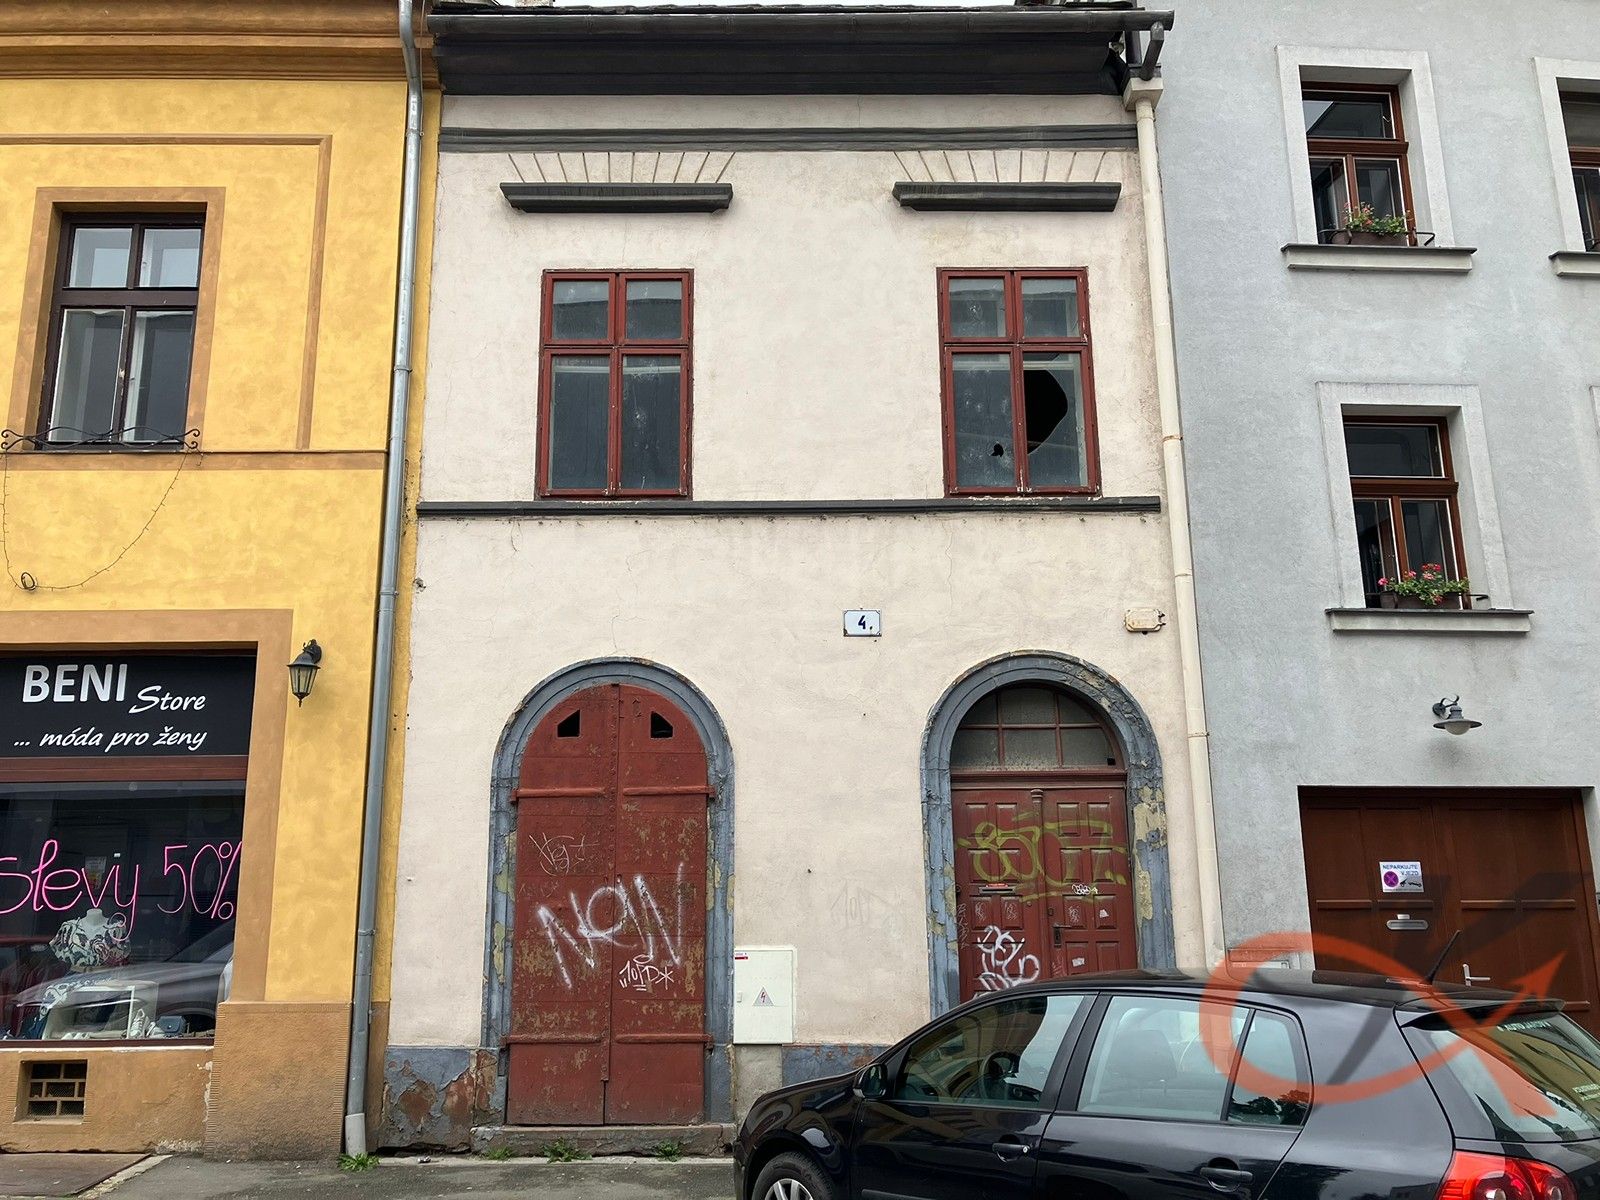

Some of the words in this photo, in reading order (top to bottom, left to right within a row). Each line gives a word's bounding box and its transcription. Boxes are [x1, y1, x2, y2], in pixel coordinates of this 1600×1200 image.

[858, 615, 873, 630] 4.
[22, 663, 128, 703] BENI
[128, 685, 207, 714] Store
[38, 726, 104, 747] móda
[104, 731, 149, 752] pro
[152, 725, 208, 751] ženy
[157, 841, 243, 920] 50%
